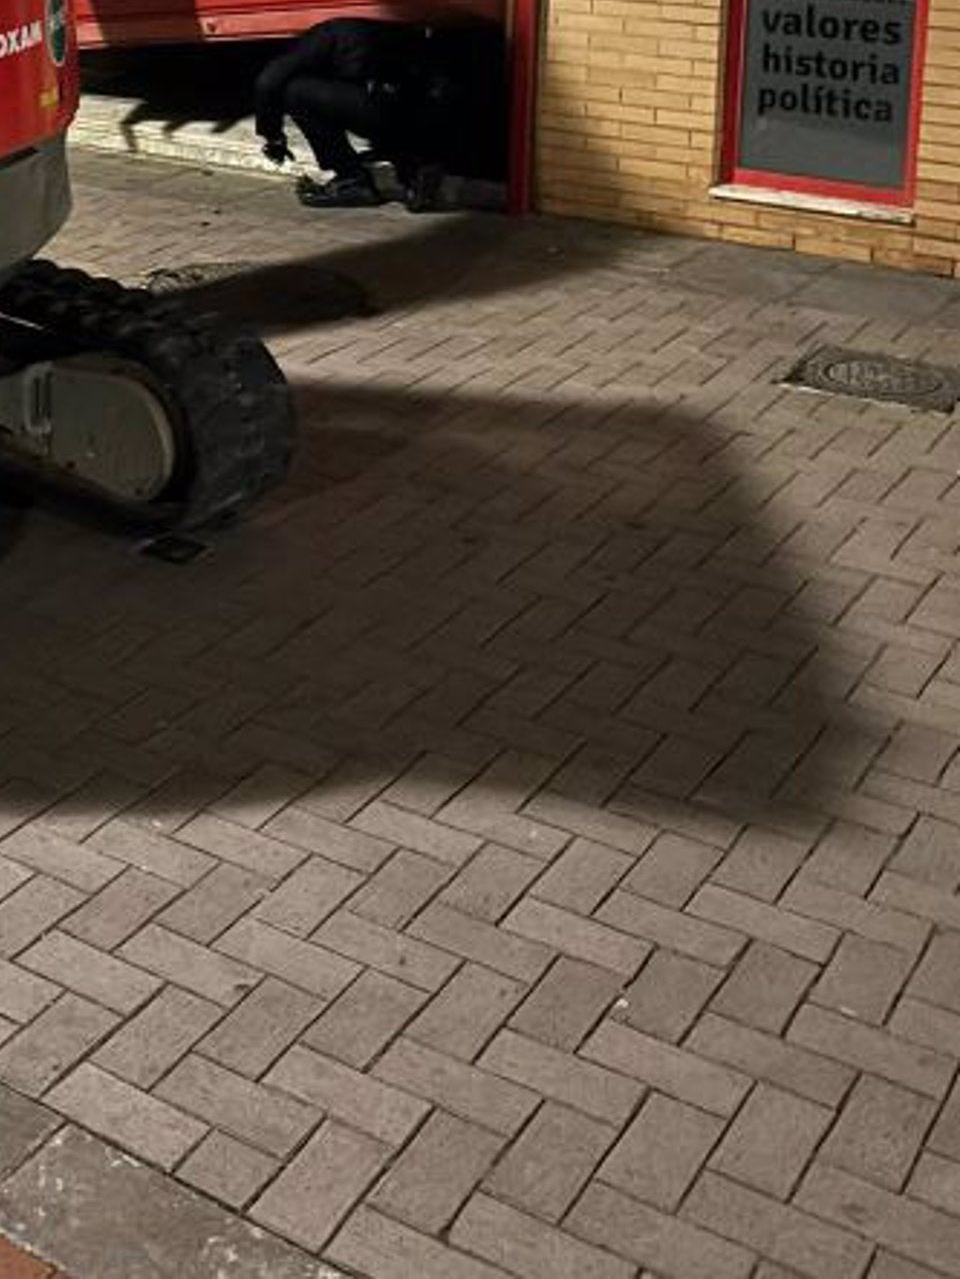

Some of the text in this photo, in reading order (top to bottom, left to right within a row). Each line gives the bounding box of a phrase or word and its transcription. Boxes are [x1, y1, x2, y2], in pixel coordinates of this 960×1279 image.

[762, 4, 902, 46] valores
[762, 45, 901, 85] historia
[757, 84, 894, 122] política
